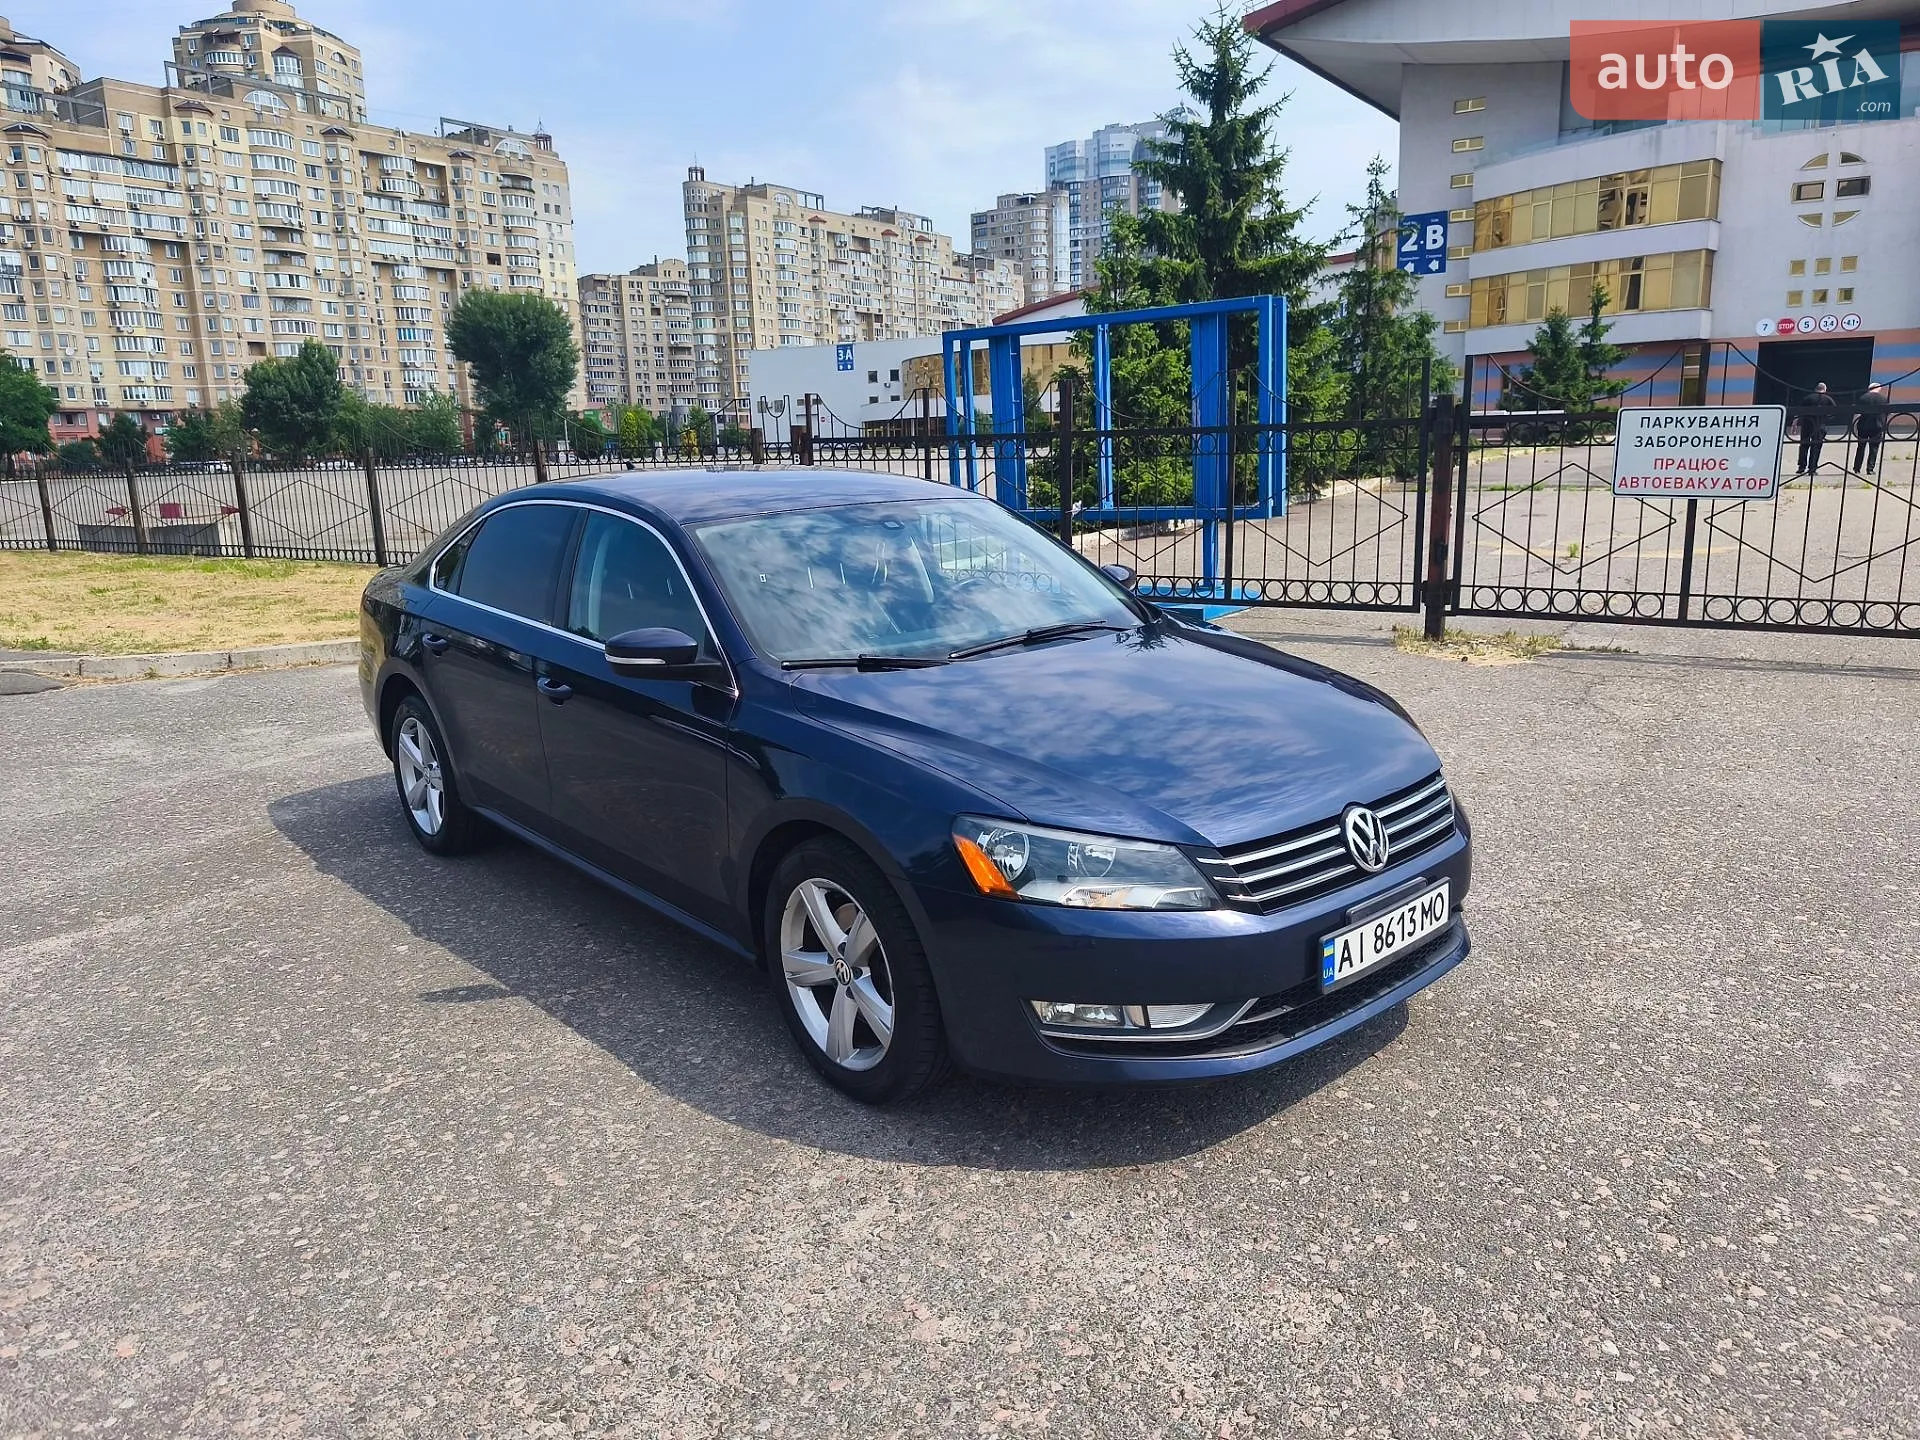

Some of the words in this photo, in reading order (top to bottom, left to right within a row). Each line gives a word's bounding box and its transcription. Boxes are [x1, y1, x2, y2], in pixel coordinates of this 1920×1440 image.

[1763, 323, 1768, 331] 7
[1640, 416, 1760, 428] ПАРКУВАННЯ
[1634, 435, 1762, 448] ЗАБОРОНЕННО
[1653, 458, 1729, 472] ПРАЦЮЄ
[1618, 477, 1769, 490] АВТОЕВАКУАТОР
[1338, 932, 1364, 973] AI
[1373, 905, 1417, 954] 8613
[1421, 891, 1445, 931] MO
[1323, 967, 1334, 979] UA
